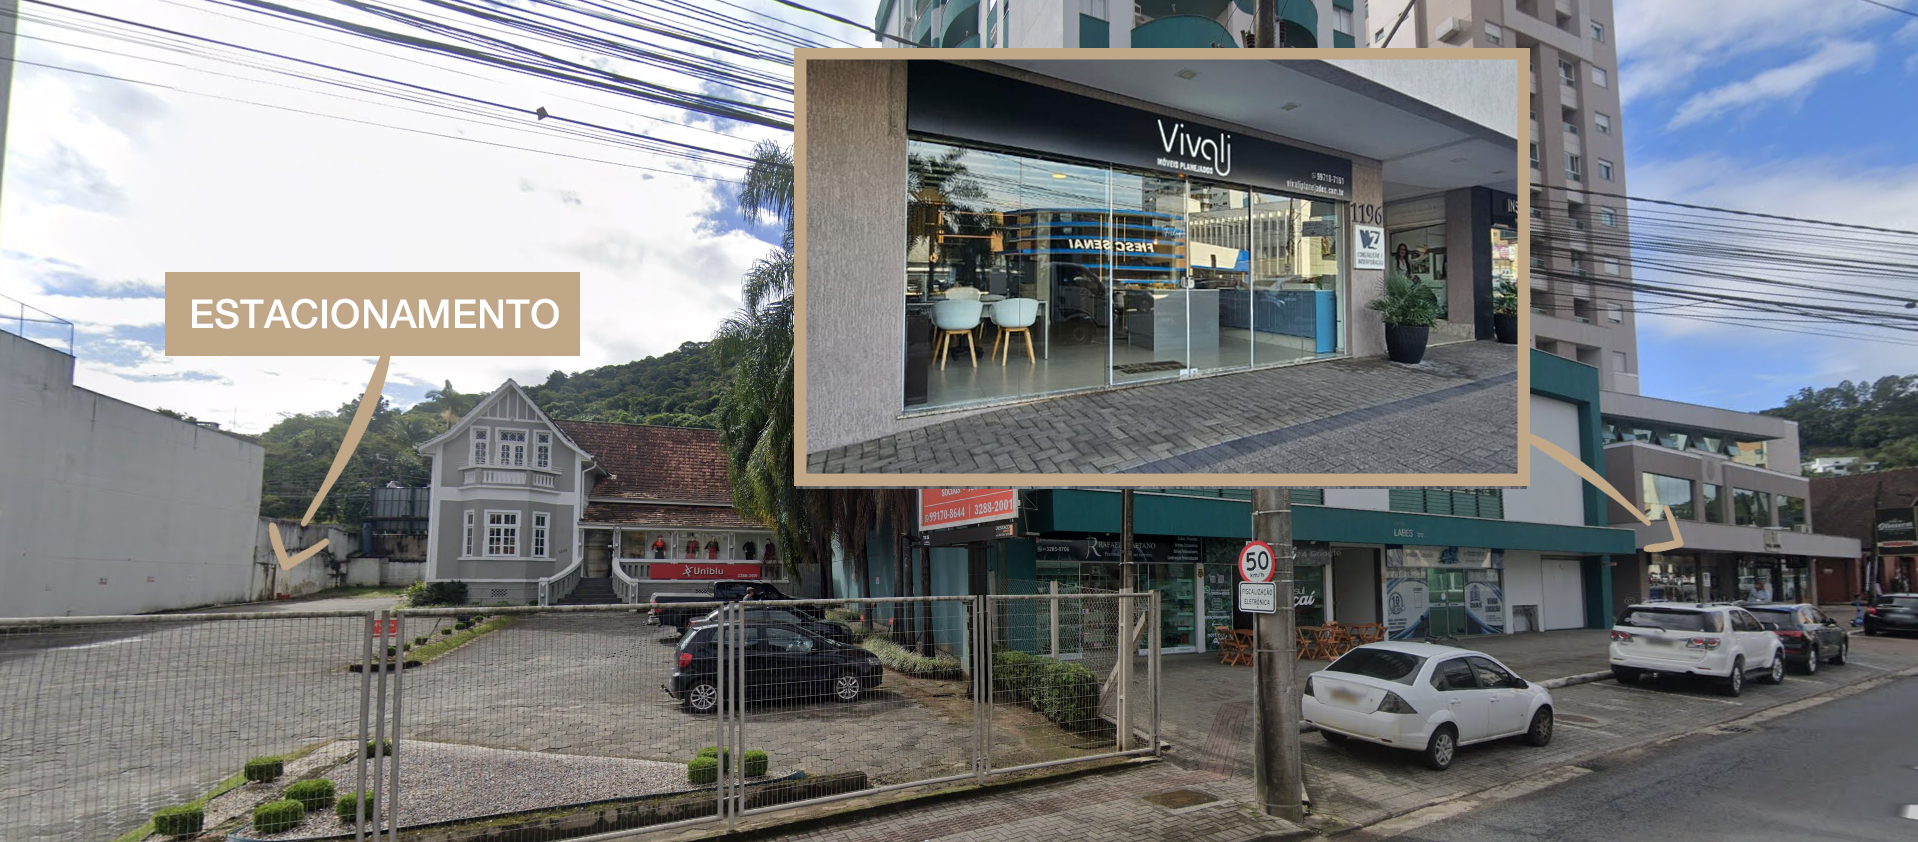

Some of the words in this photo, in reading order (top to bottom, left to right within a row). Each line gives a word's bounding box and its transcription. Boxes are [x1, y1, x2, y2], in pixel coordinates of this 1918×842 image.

[1156, 157, 1179, 169] MÓVEIS
[1180, 161, 1214, 175] PLANEJADOS
[1350, 202, 1382, 226] 1196
[929, 507, 966, 522] 99170-8644
[974, 499, 1014, 516] 3288-2001
[1393, 528, 1414, 538] LABES
[1246, 551, 1269, 571] 50
[693, 566, 724, 576] Uniblu
[1242, 587, 1273, 596] FISCALIZAÇÃO
[1243, 597, 1271, 606] ELETRÔNICA
